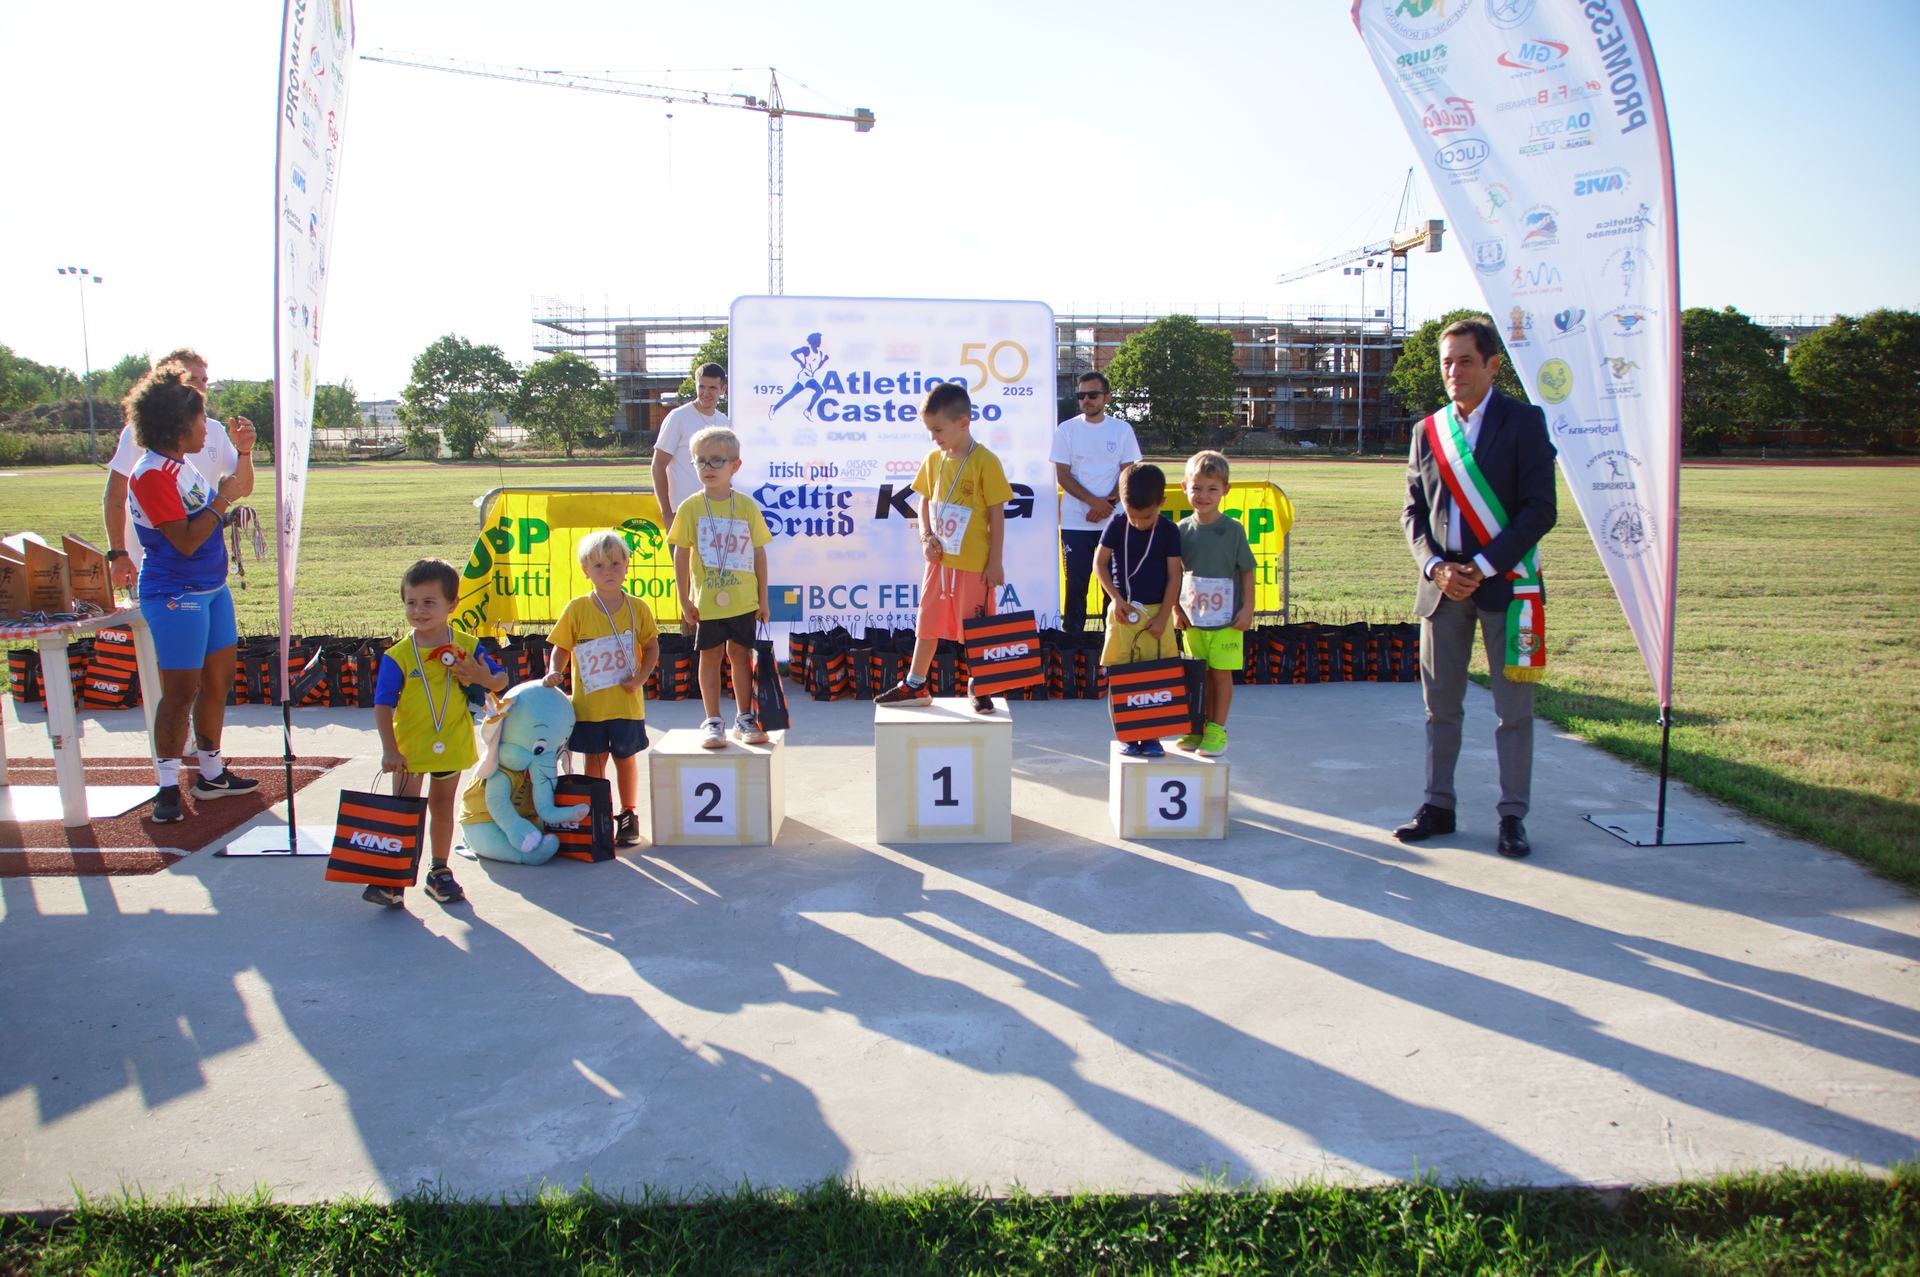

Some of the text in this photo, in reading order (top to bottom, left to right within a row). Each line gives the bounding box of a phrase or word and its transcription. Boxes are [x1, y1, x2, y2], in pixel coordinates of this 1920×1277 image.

[959, 340, 1029, 394] 50
[753, 385, 784, 395] 1975
[1003, 387, 1033, 396] 2025
[817, 398, 1002, 423] Casteso
[769, 461, 839, 481] irish pub
[752, 482, 853, 510] Celtic
[875, 483, 1035, 519] KG
[760, 510, 854, 537] Druid
[709, 532, 750, 555] 497
[493, 569, 550, 597] tutti
[621, 578, 676, 599] spor
[809, 585, 868, 610] BCC
[810, 613, 917, 622] CREDITO COOPER
[99, 630, 127, 643] KING
[588, 650, 627, 676] 228
[984, 643, 1029, 660] KING
[93, 681, 120, 692] KING
[1127, 690, 1172, 707] KING
[932, 766, 959, 807] 1
[694, 782, 724, 823] 2
[1158, 780, 1187, 821] 3
[350, 831, 403, 853] KING
